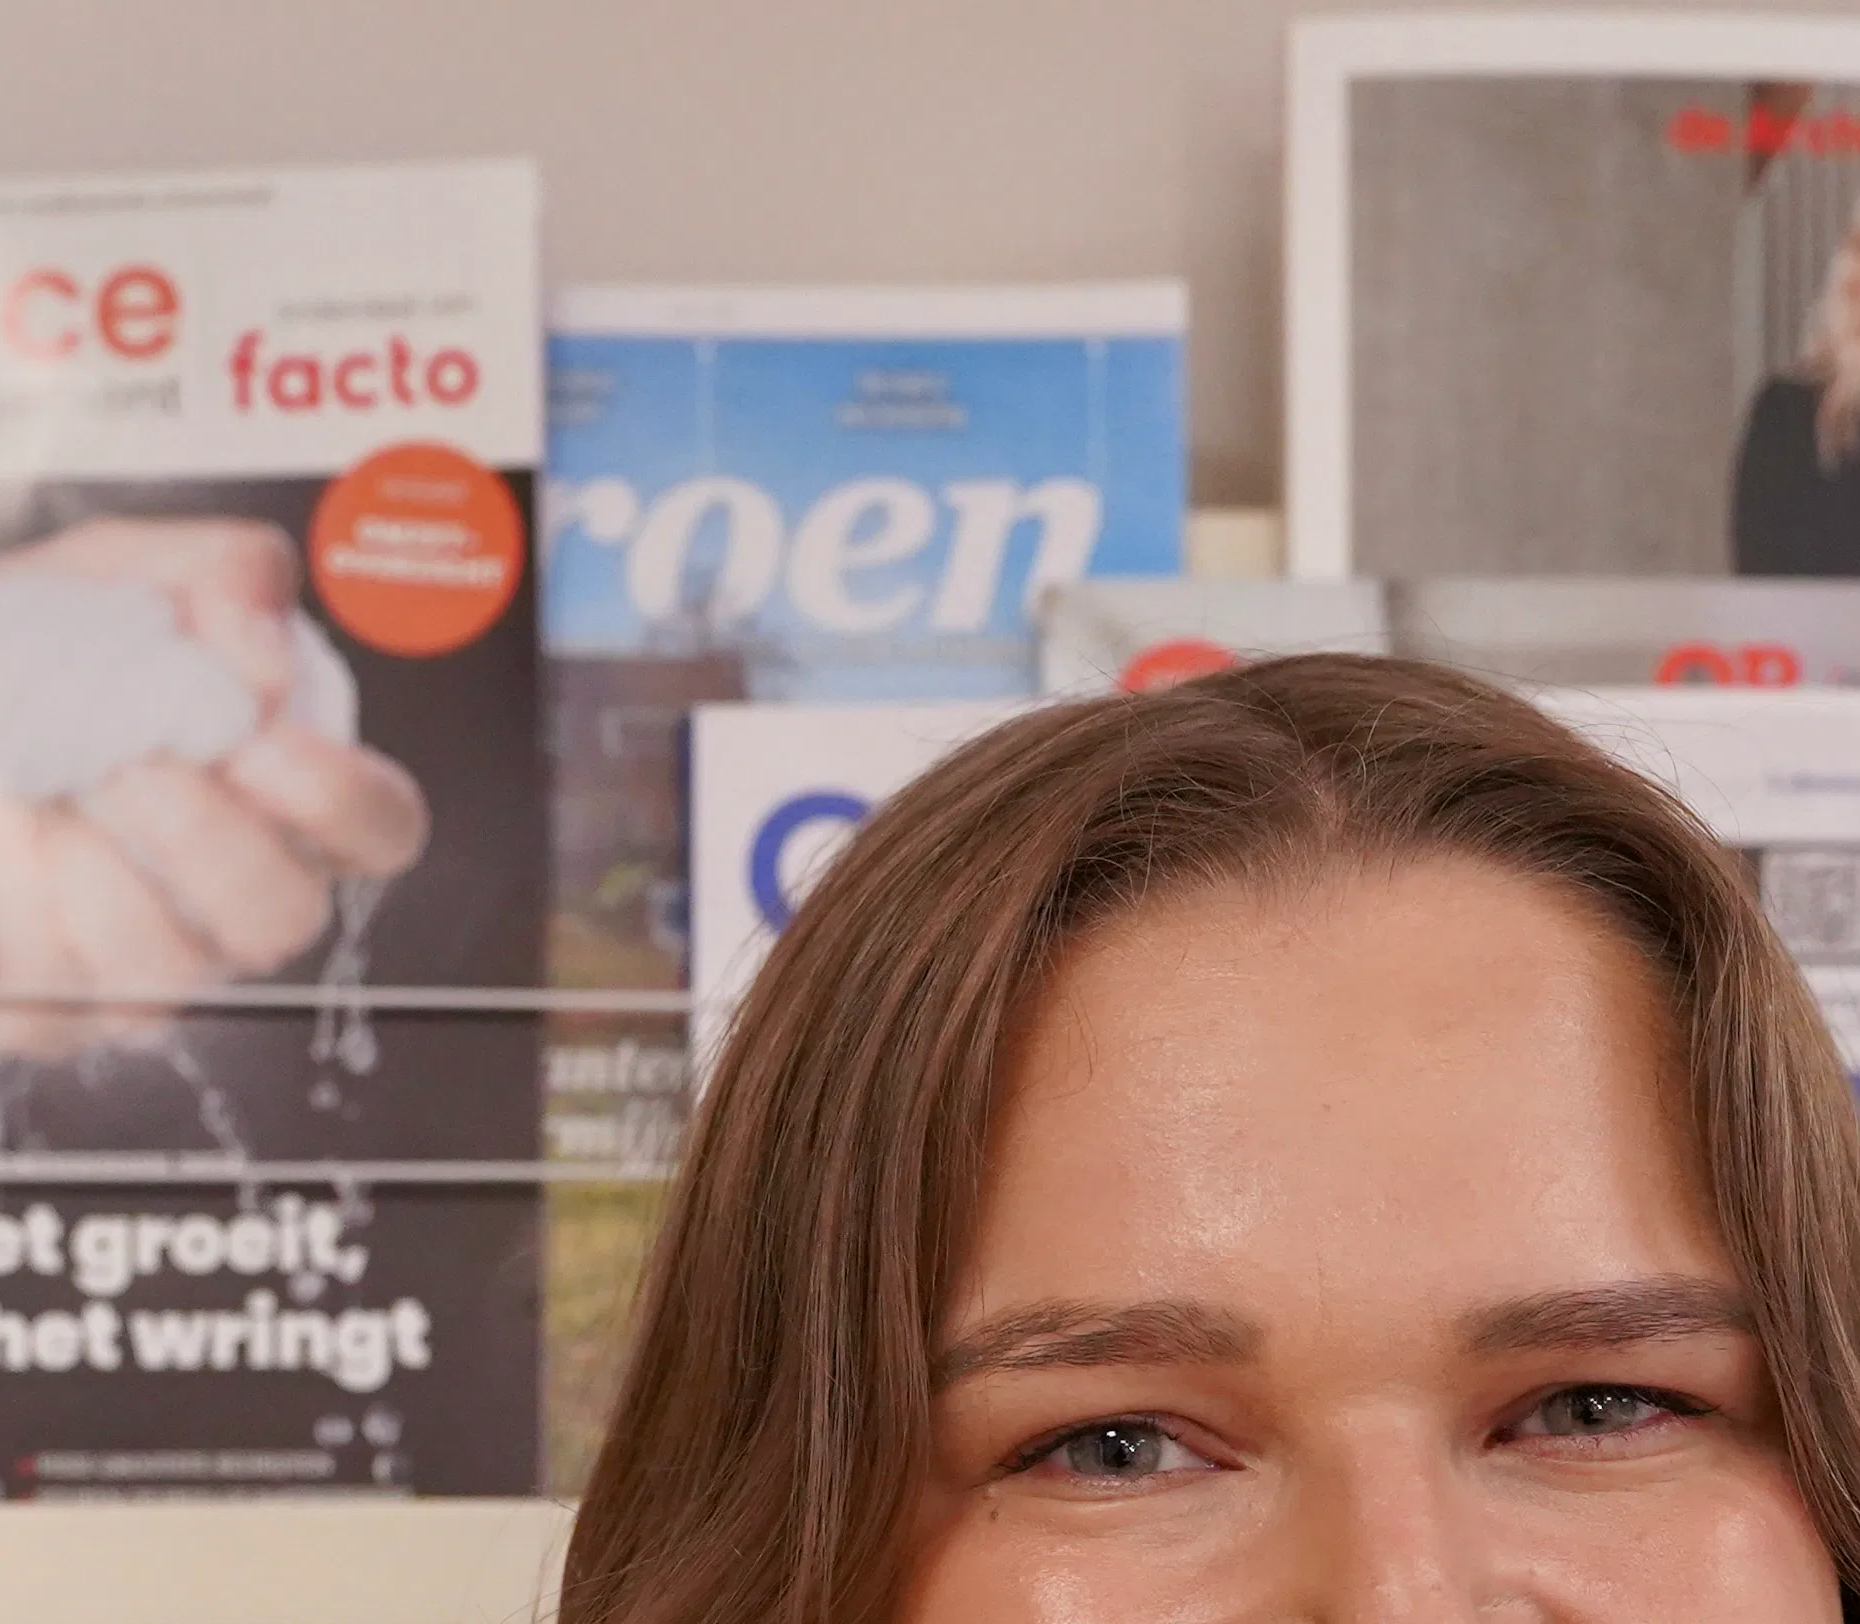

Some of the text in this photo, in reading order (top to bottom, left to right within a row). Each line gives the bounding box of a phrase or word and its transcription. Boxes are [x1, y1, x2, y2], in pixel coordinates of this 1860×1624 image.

[227, 330, 481, 414] facto
[70, 1192, 370, 1296] groeit,
[129, 1290, 431, 1392] wringt
